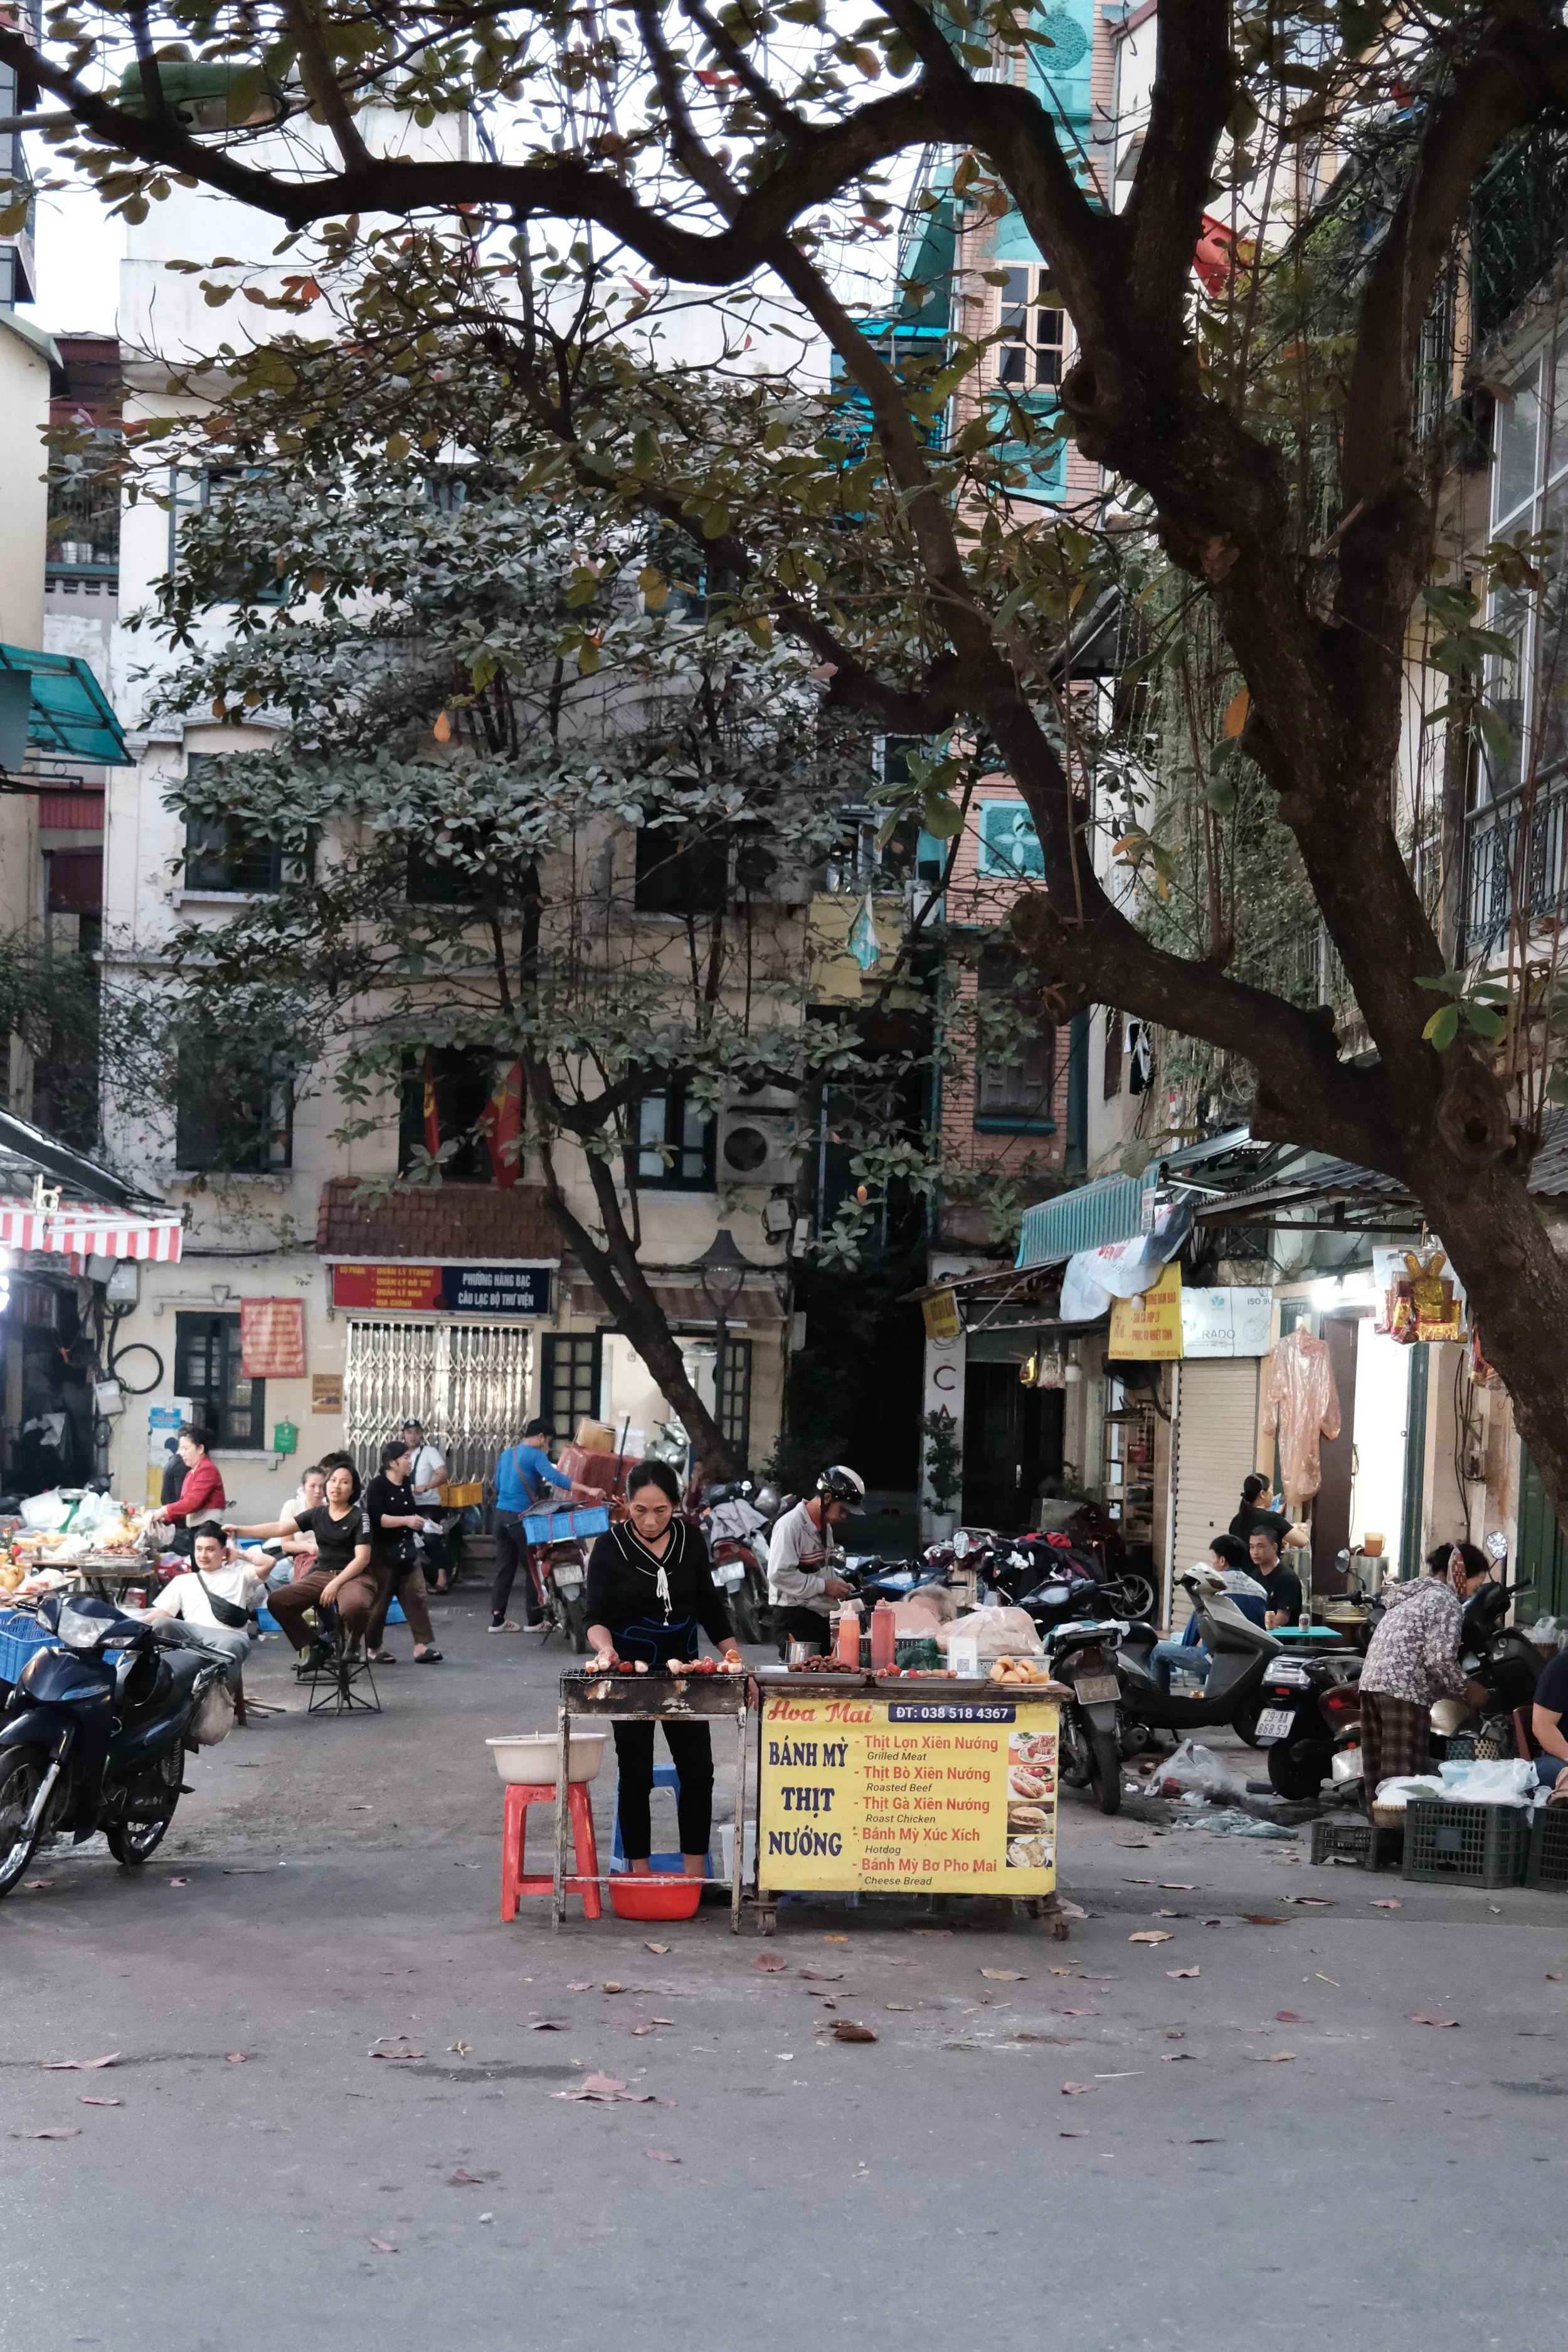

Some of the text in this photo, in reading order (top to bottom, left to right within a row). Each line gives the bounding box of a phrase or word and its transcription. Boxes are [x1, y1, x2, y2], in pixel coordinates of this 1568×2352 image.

[463, 1270, 531, 1290] PHƯỜNG HÀNG BẠC
[458, 1290, 534, 1309] CÂU LẠC BỘ THƯ VIỆN
[767, 1700, 874, 1724] Hoa Mai
[896, 1707, 1009, 1719] ĐT: 038 518 4367
[1264, 1711, 1289, 1724] 29-AA
[1257, 1722, 1288, 1736] 868.53
[769, 1735, 849, 1767] BÁNH MỲ
[864, 1735, 999, 1752] Thịt Lợn Xiên Nướng
[867, 1751, 926, 1761] Grilled Meat
[863, 1766, 990, 1783] Thịt Bò Xiên Nướng
[866, 1783, 933, 1793] Roasted Beef
[781, 1786, 835, 1818] THỊT
[862, 1796, 990, 1814] Thịt Gà Xiên Nướng
[866, 1814, 936, 1823] Roast Chicken
[768, 1825, 843, 1857] NƯỚNG
[862, 1826, 980, 1844] Bánh Mỳ Xúc Xích
[865, 1845, 901, 1855] Hotdog
[862, 1857, 997, 1874] Bánh Mỳ Bơ Pho Mai
[864, 1876, 933, 1886] Cheese Bread
